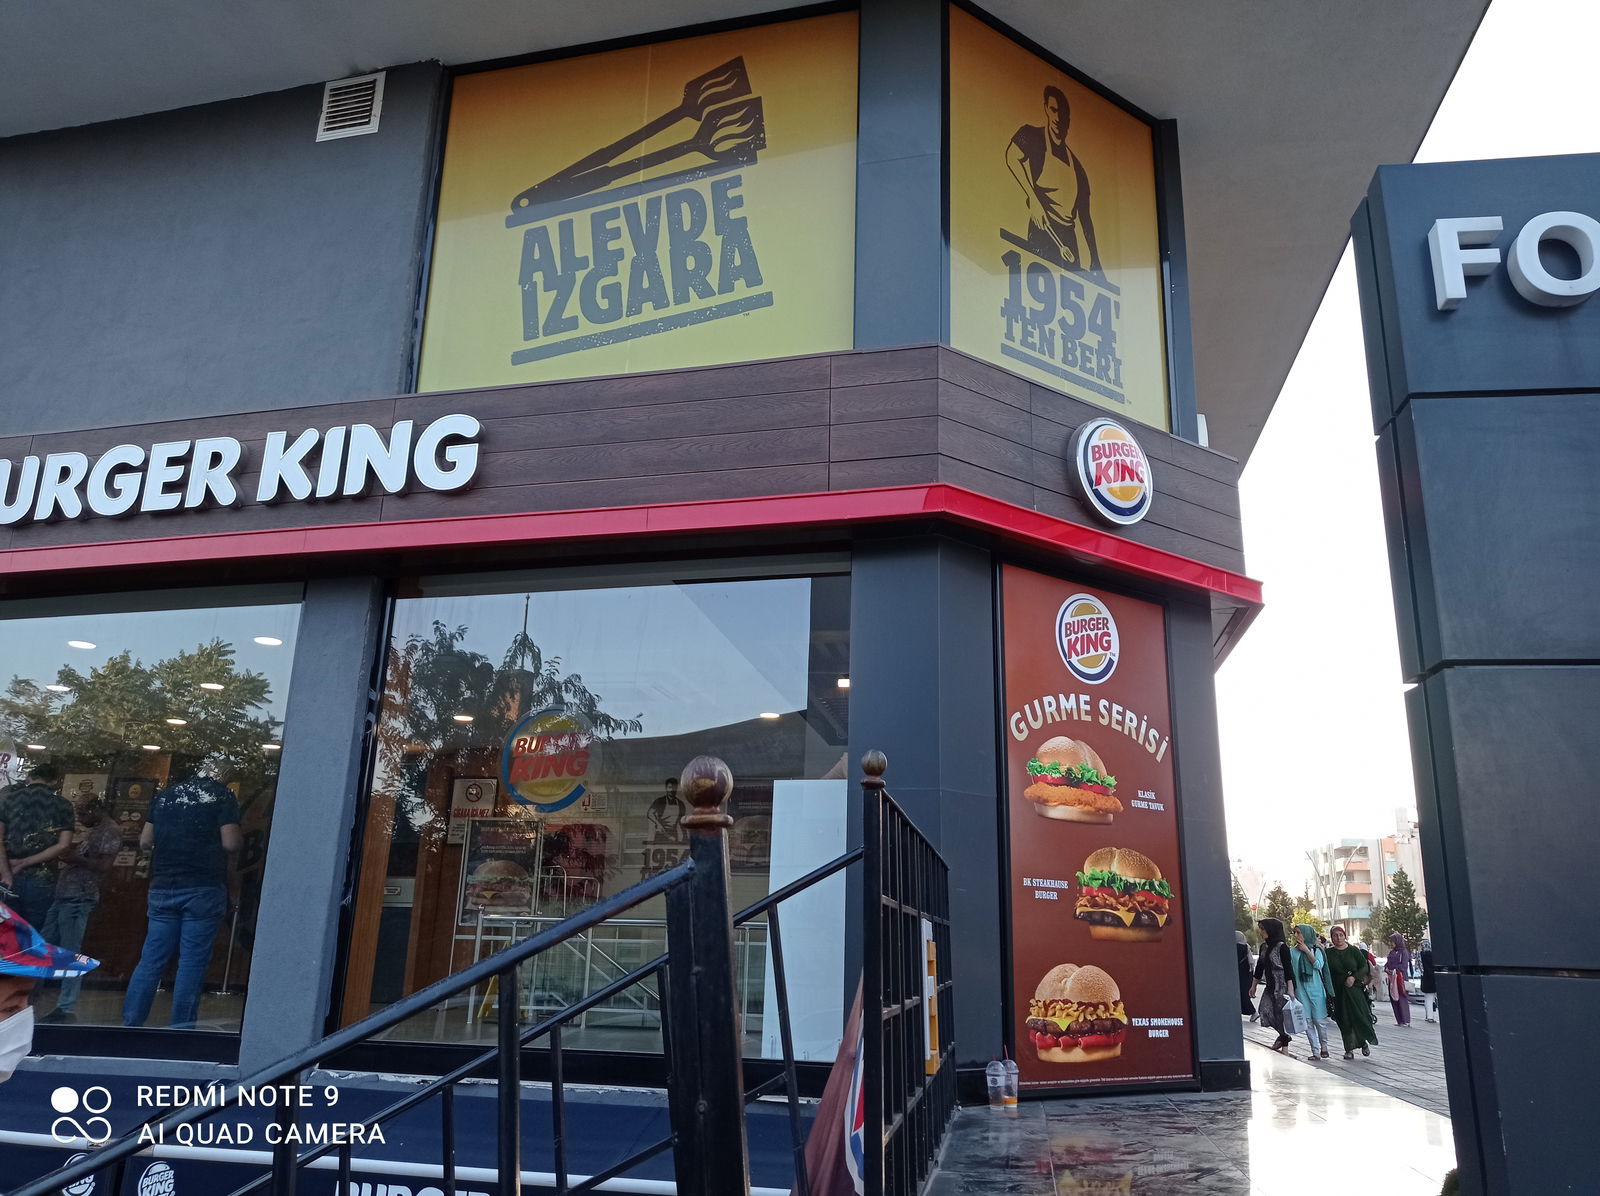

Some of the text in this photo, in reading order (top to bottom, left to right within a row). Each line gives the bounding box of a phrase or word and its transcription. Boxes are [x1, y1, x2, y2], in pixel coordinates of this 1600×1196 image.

[518, 175, 748, 286] ALEVDE
[522, 225, 763, 341] IZGARA
[1001, 306, 1056, 360] TEN
[256, 413, 481, 502] KING
[1091, 442, 1142, 462] BURGER
[1094, 459, 1145, 487] KING
[1064, 617, 1109, 638] BURGER
[1067, 631, 1112, 660] KING
[1010, 693, 1169, 763] GURME SERİSİ
[509, 752, 592, 784] KING
[1023, 877, 1032, 887] BK
[1034, 890, 1058, 900] BURGER
[1132, 1017, 1184, 1027] TEXAS SMOKEHOUSE
[1148, 1029, 1169, 1038] BURGER
[143, 1169, 174, 1187] BURGER
